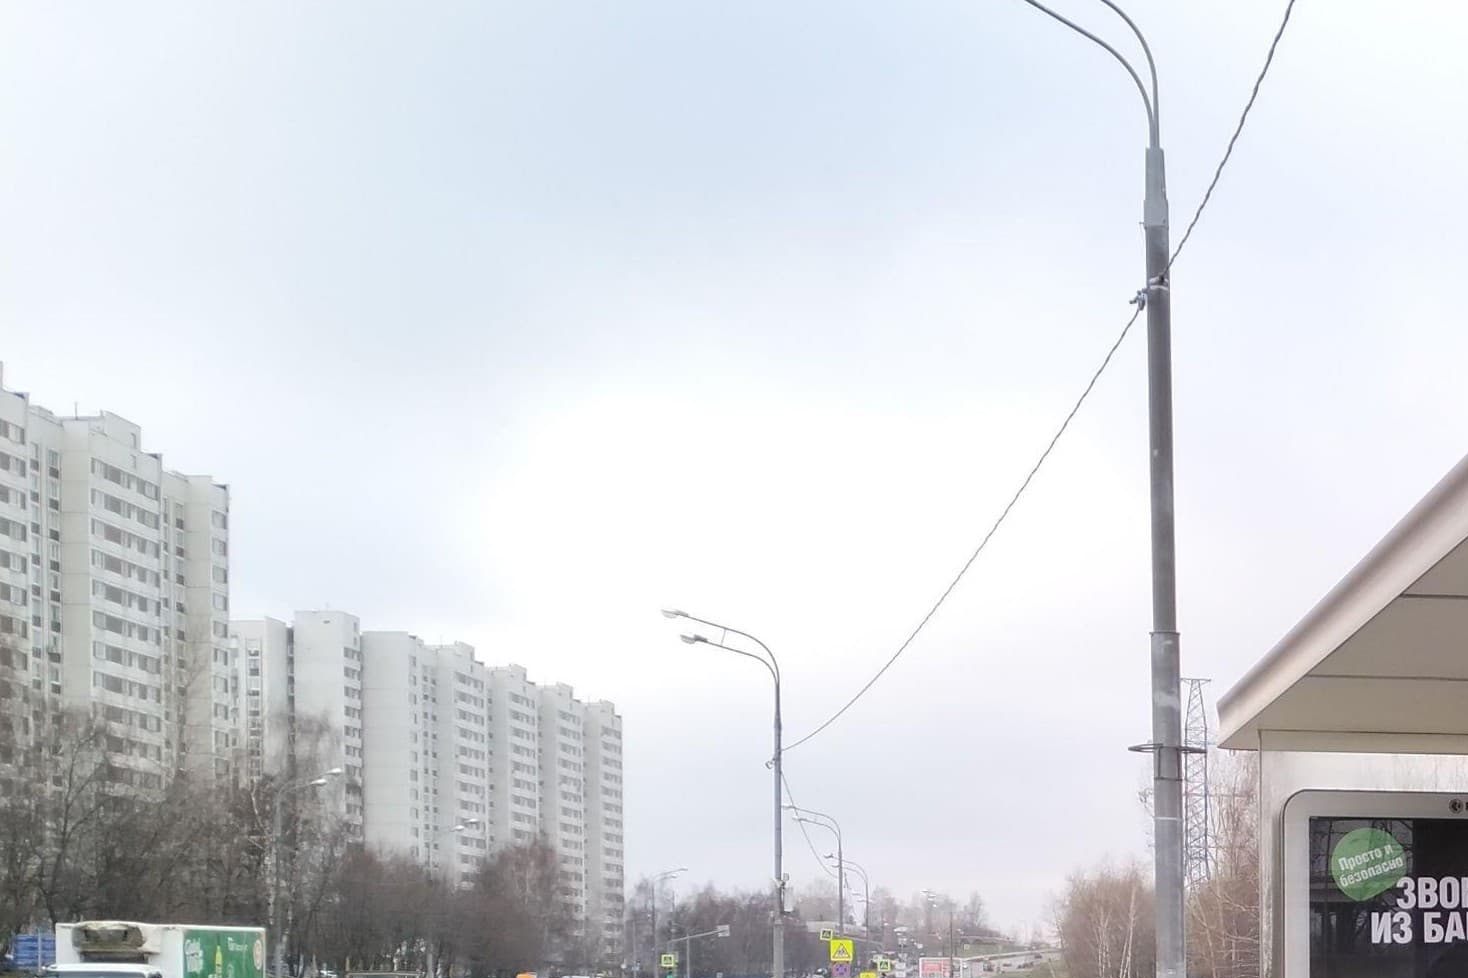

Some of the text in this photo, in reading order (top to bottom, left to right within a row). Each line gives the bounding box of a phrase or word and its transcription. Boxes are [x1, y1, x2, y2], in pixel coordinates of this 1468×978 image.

[1337, 844, 1394, 872] Просто и
[1338, 855, 1404, 888] безопасно
[1371, 911, 1413, 944] ИЗ
